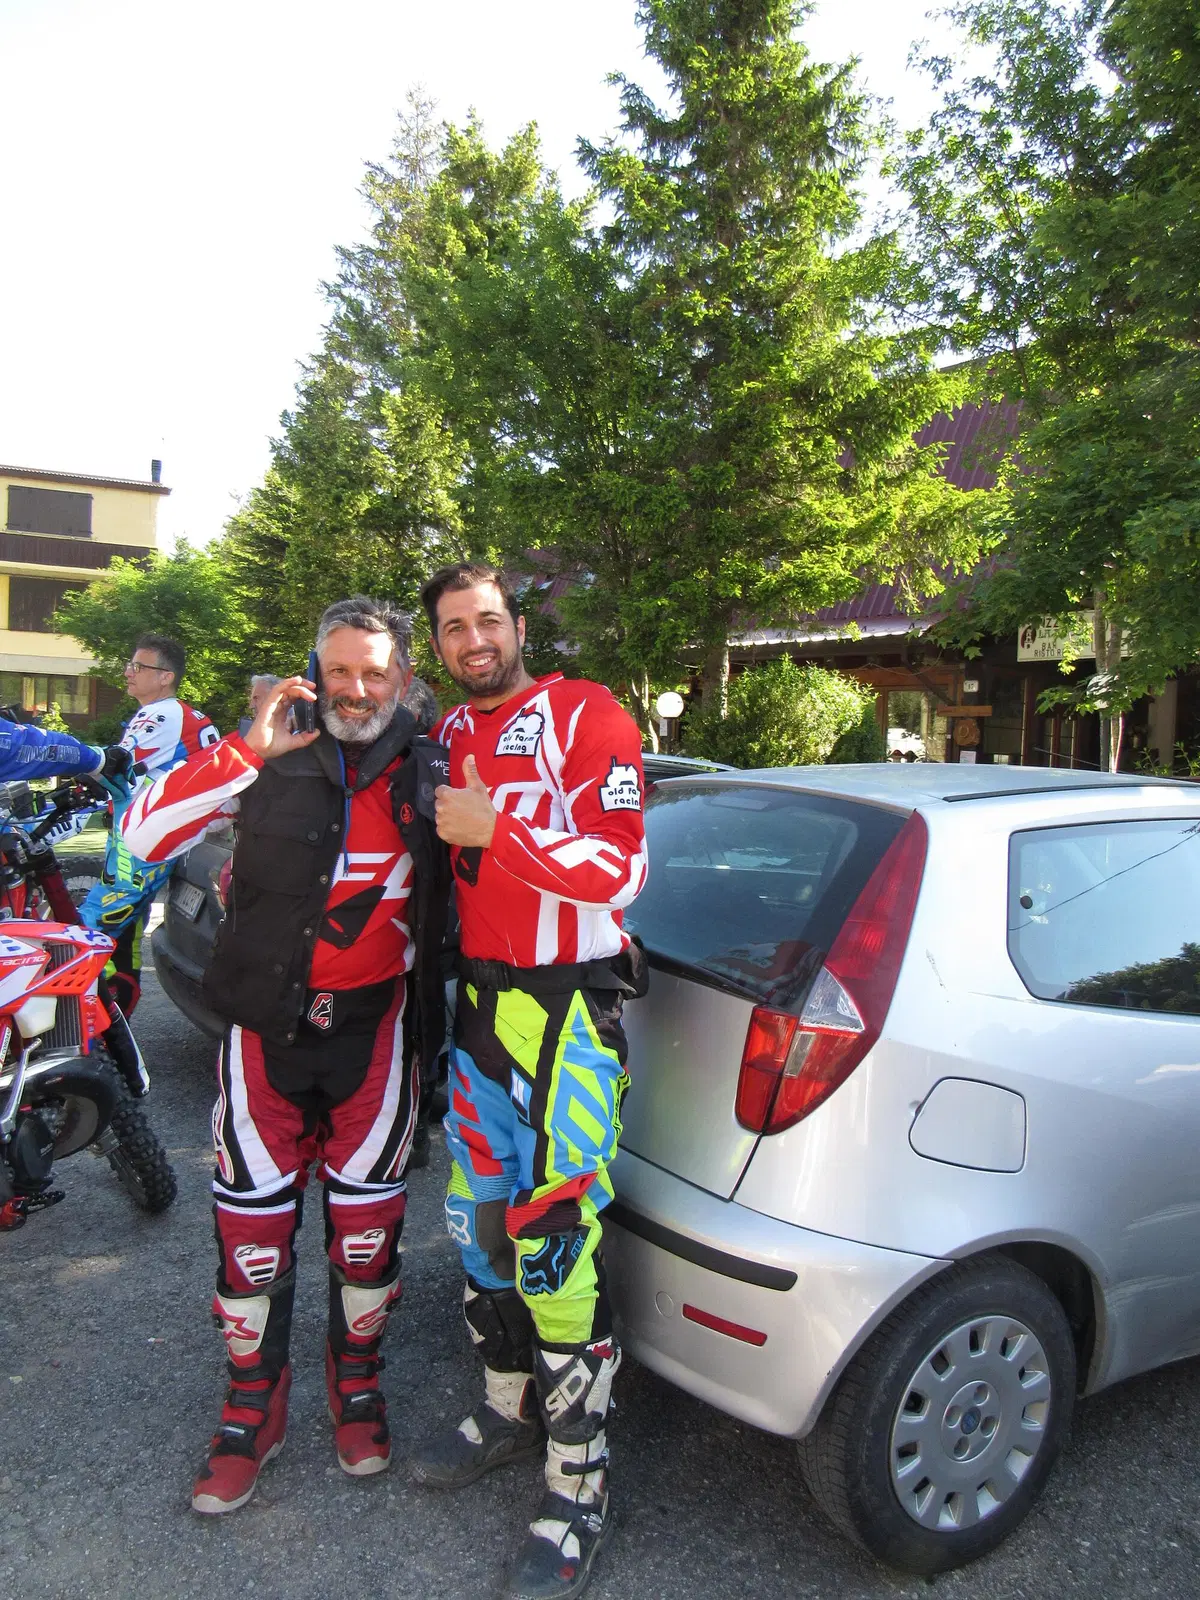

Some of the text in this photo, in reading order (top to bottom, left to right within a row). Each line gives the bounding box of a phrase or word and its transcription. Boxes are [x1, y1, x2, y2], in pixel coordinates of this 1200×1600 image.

[503, 743, 527, 754] racing
[608, 787, 639, 795] old fa
[614, 797, 639, 806] racin
[570, 1232, 586, 1260] FOX
